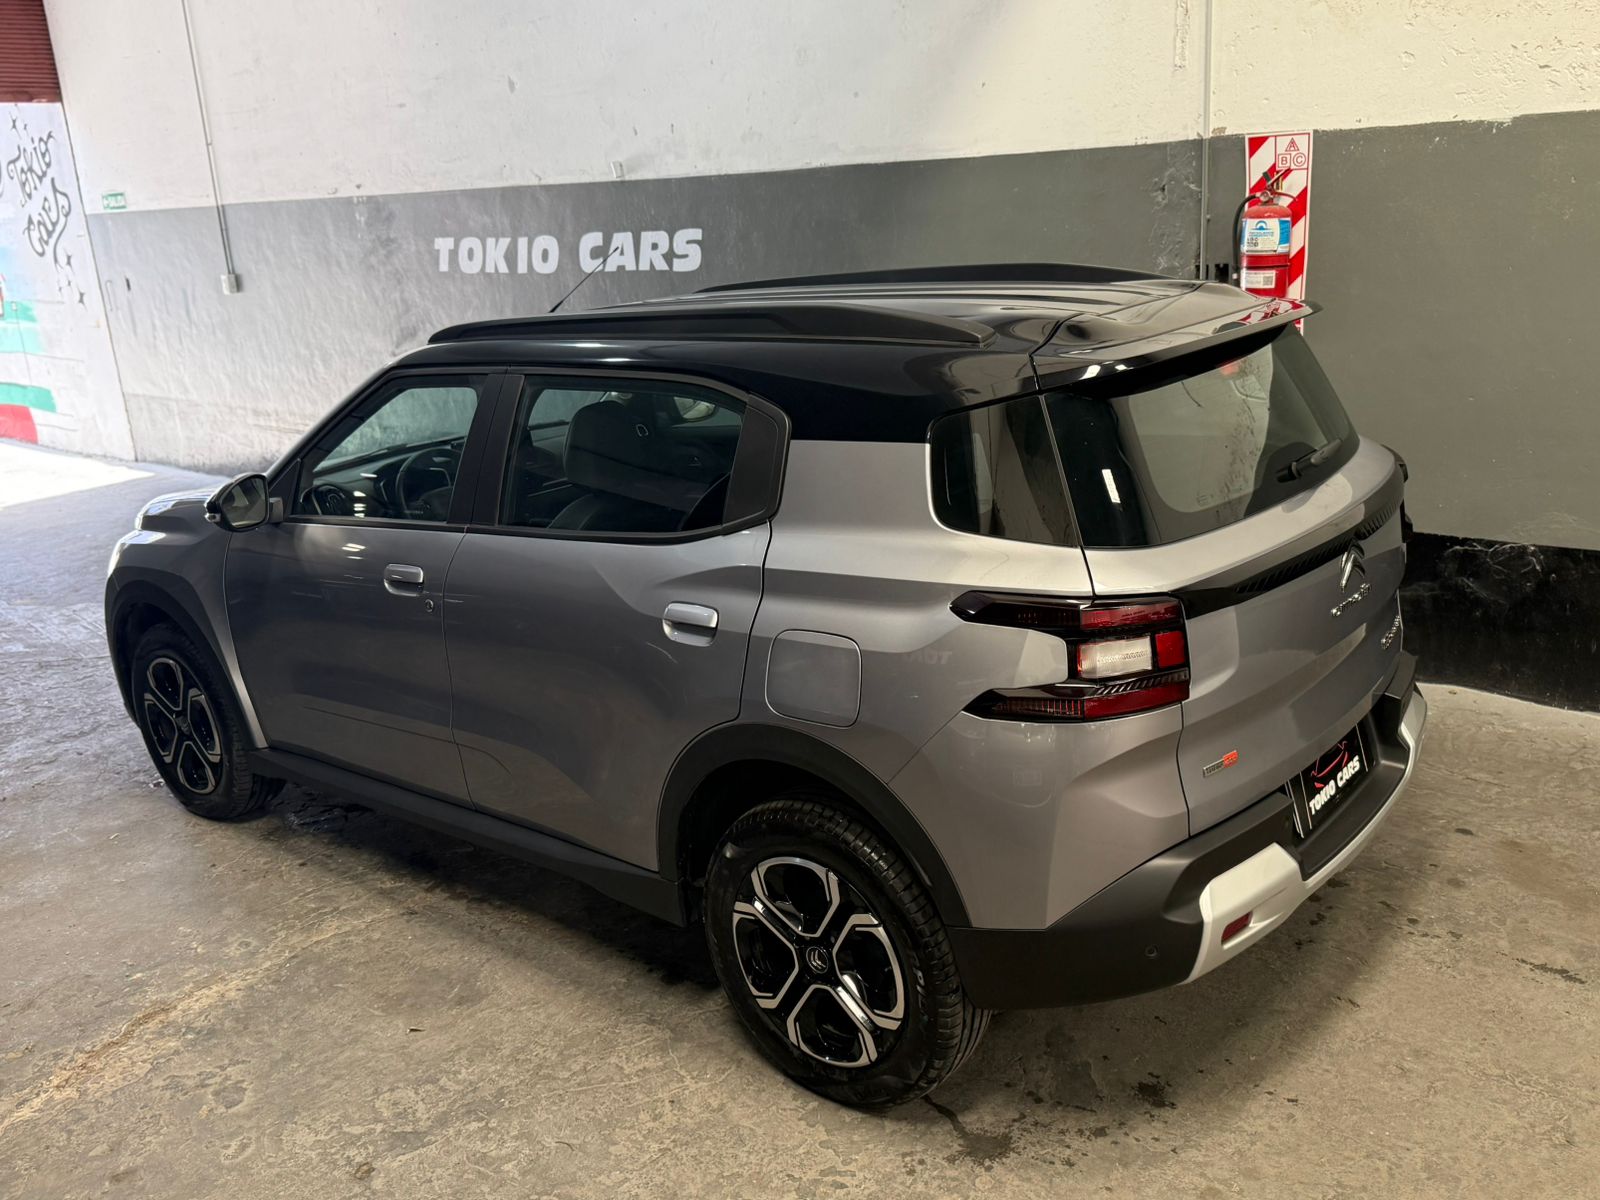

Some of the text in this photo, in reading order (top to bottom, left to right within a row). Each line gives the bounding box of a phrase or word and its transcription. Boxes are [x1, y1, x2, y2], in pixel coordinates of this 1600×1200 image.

[434, 228, 703, 274] TOKIO CARS
[1309, 755, 1360, 815] TOKIO CARS
